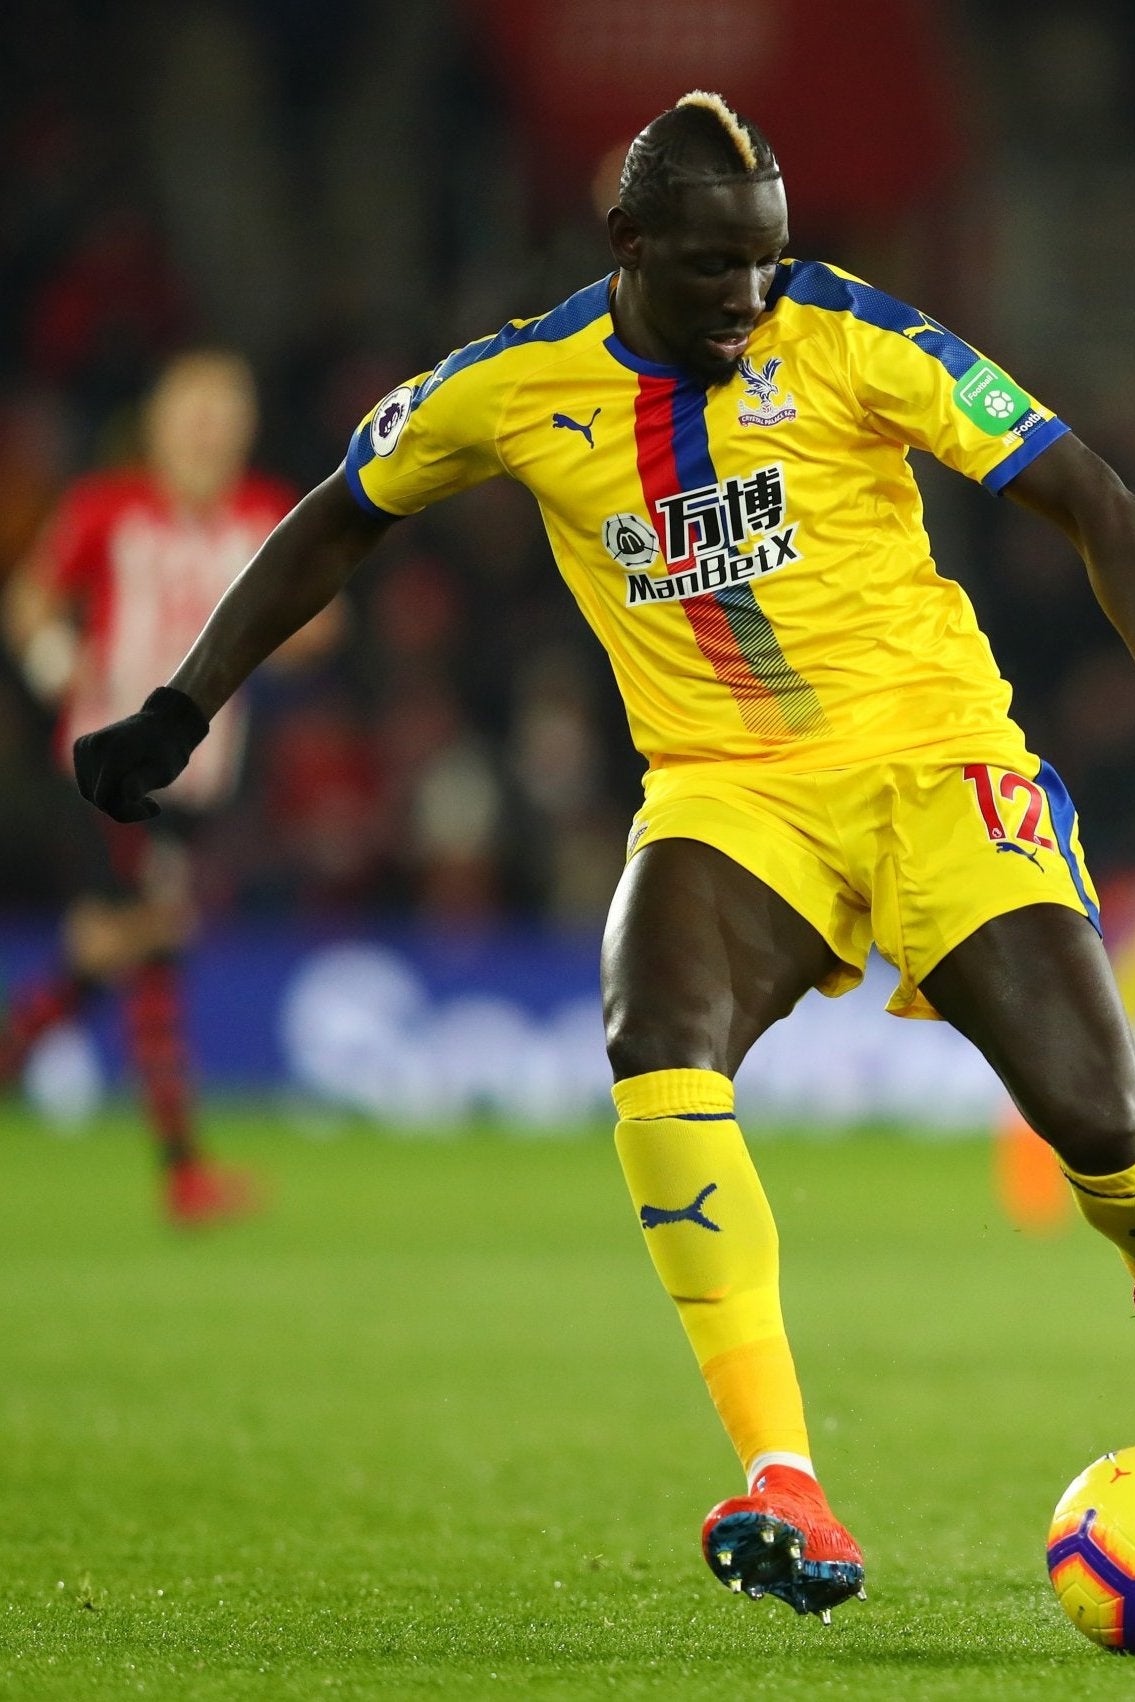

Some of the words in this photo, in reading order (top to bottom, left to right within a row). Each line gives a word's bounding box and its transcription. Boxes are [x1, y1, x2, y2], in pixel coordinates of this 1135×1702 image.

[968, 375, 994, 401] Football
[659, 467, 783, 560] 万博
[628, 527, 798, 604] ManBetX
[962, 762, 1055, 851] 12
